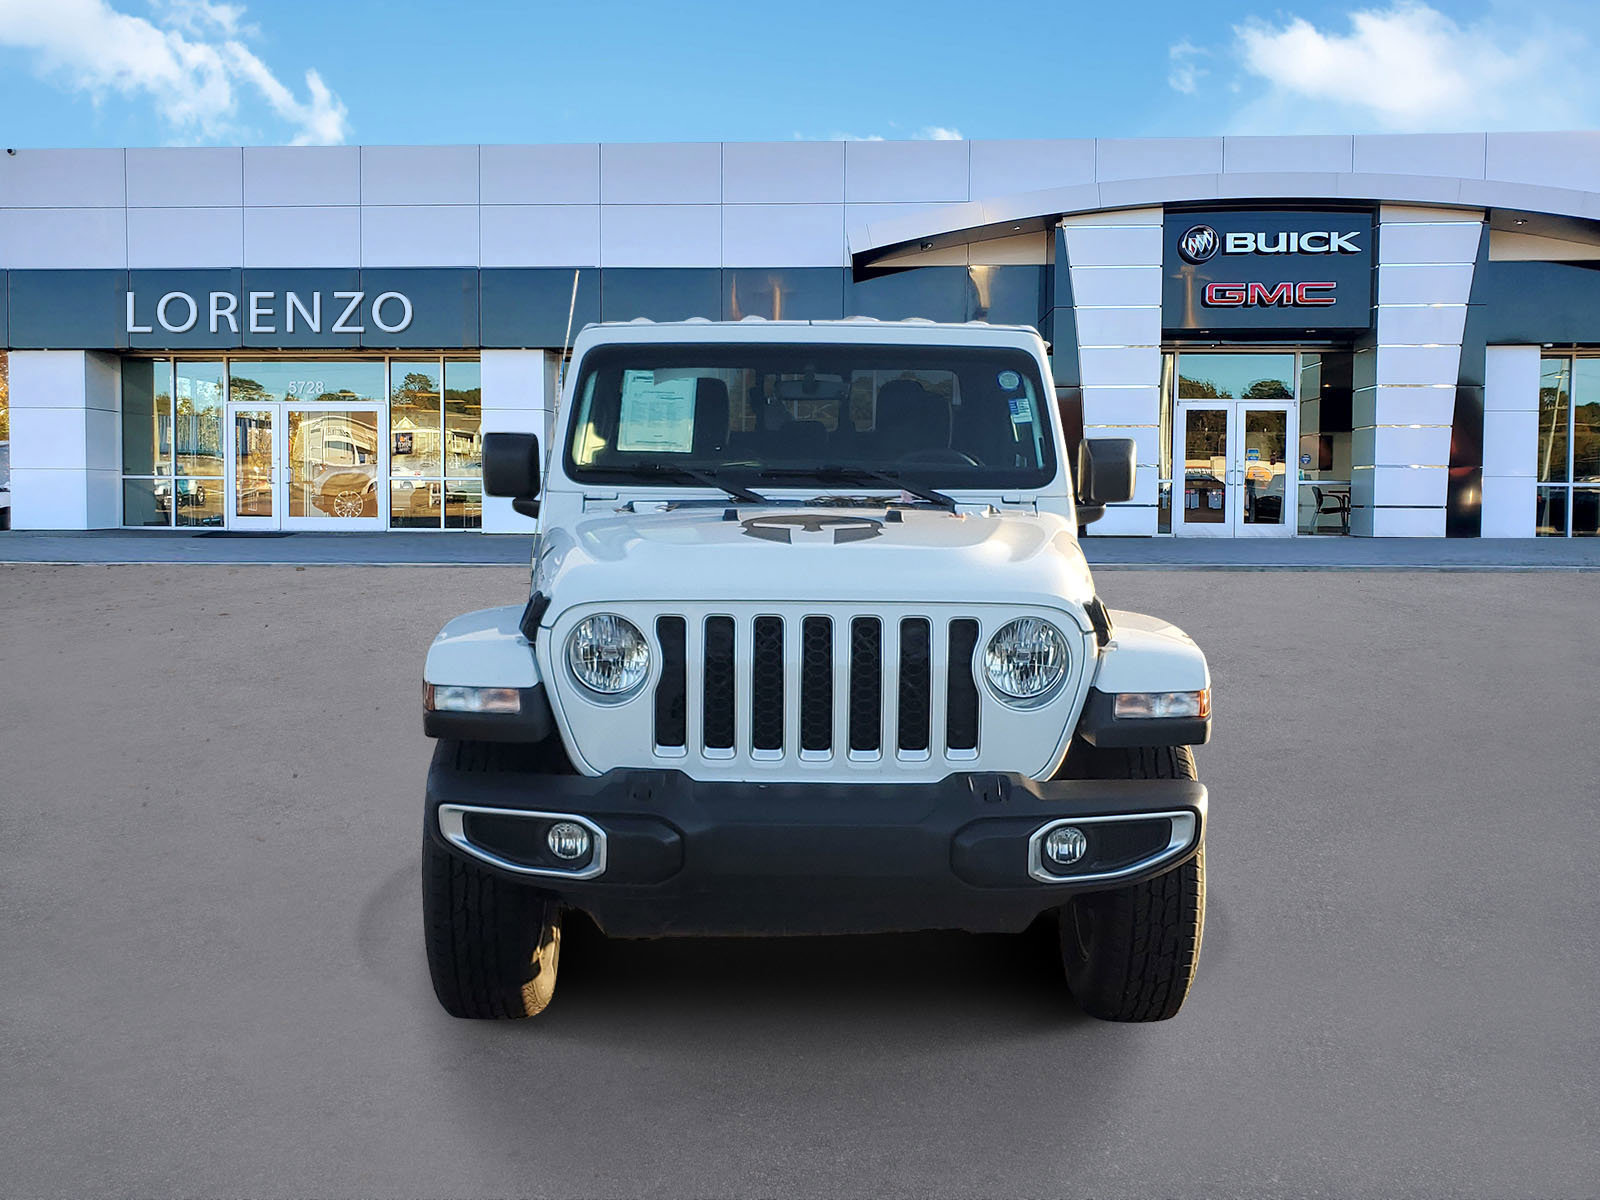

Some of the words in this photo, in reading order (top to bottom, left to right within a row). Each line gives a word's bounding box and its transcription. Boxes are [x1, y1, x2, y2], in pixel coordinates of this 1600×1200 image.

[1225, 231, 1362, 253] BUICK
[1205, 281, 1337, 306] GMC
[126, 291, 413, 333] LORENZO
[288, 380, 325, 394] 5728
